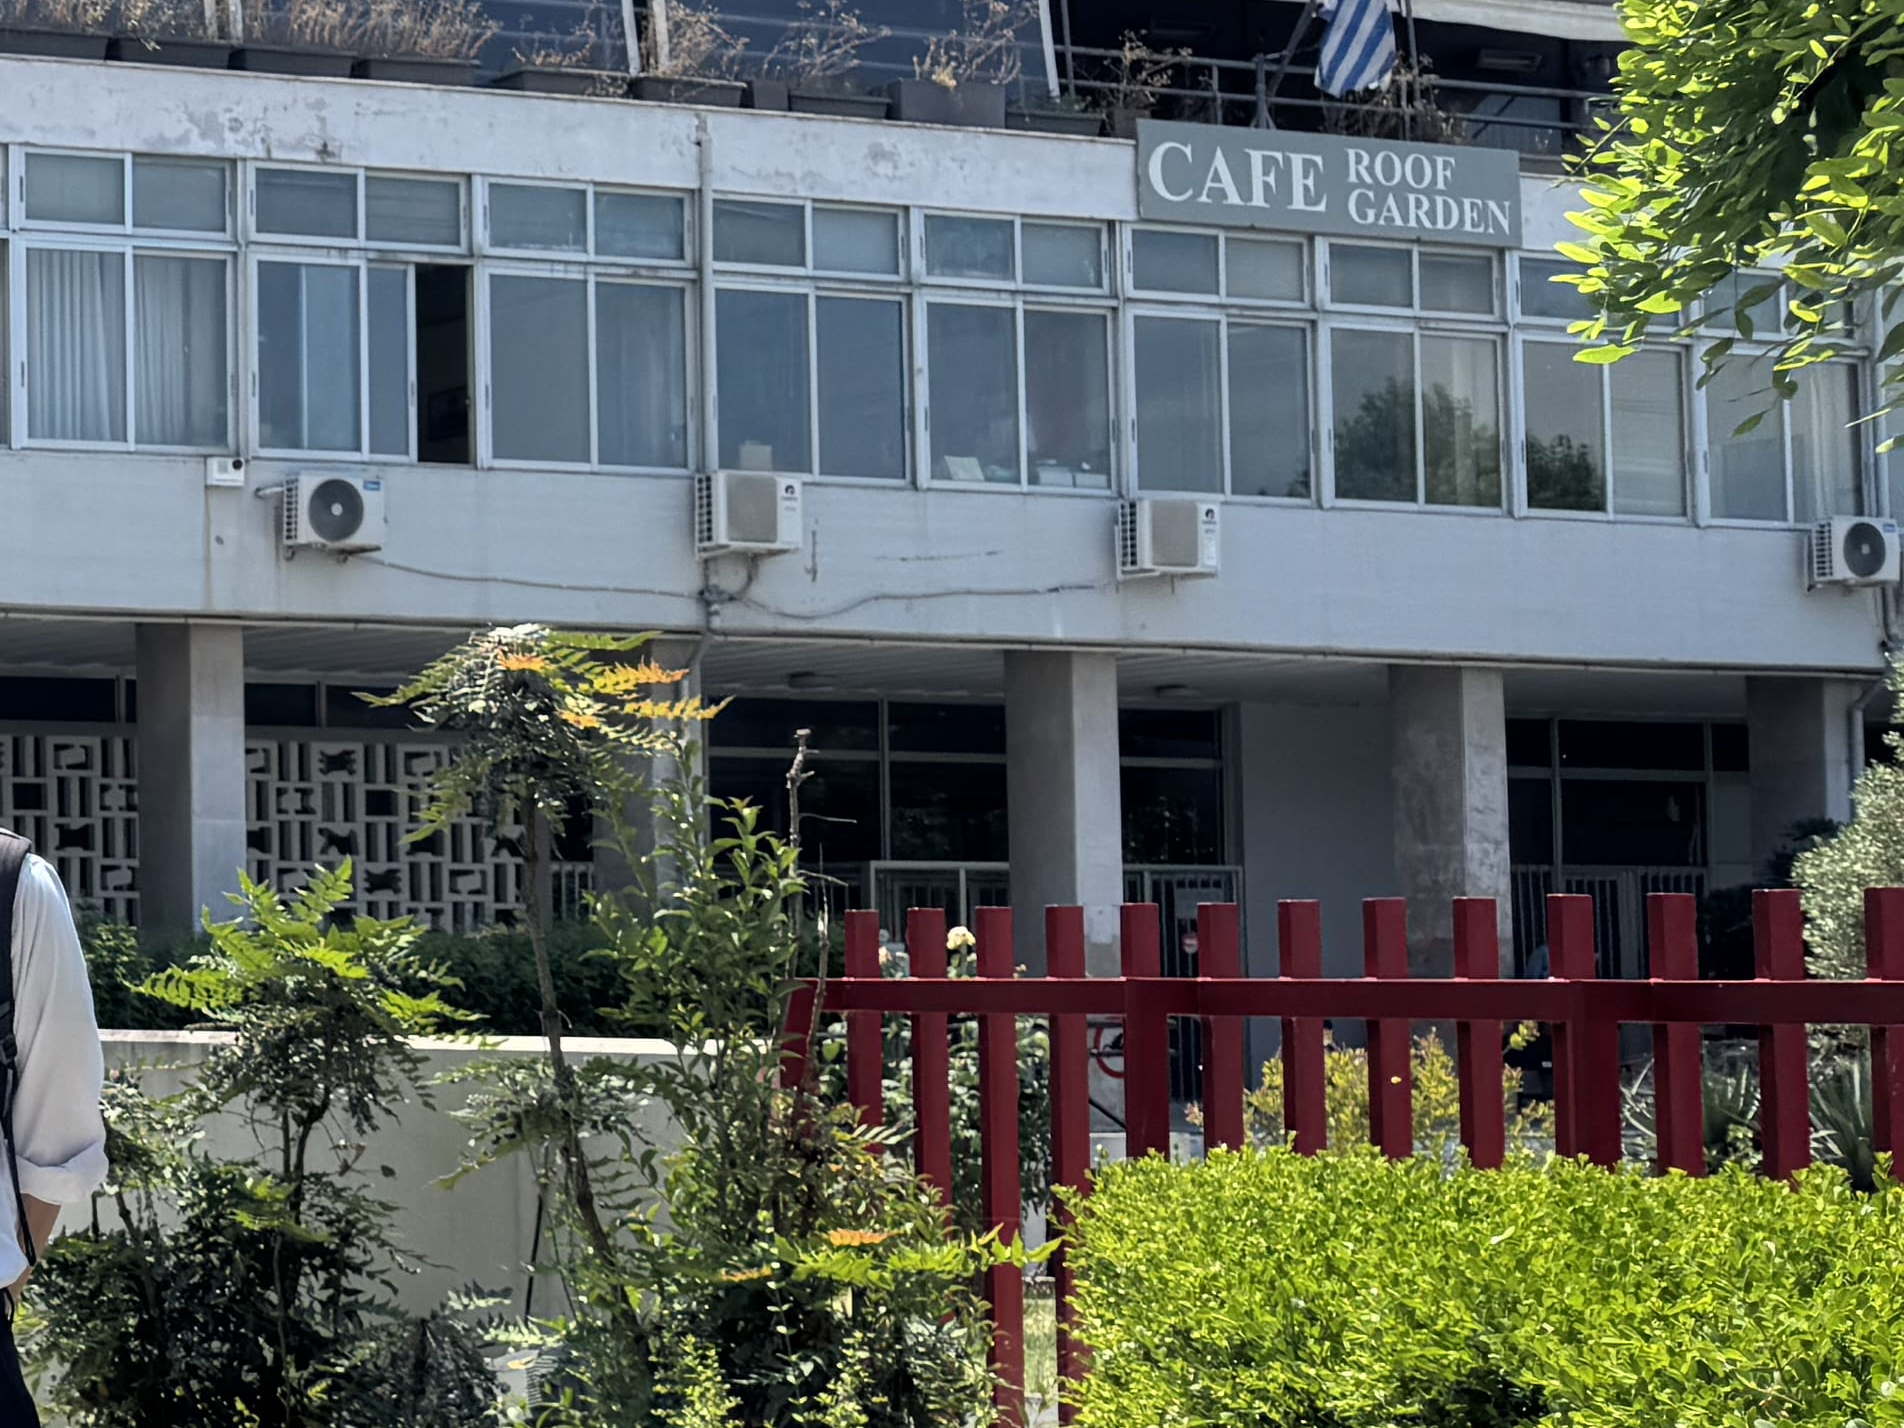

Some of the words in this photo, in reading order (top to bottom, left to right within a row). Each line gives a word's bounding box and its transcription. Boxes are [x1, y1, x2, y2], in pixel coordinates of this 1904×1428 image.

[1147, 140, 1327, 213] CAFE
[1344, 147, 1456, 191] ROOF
[1347, 188, 1513, 235] GARDEN
